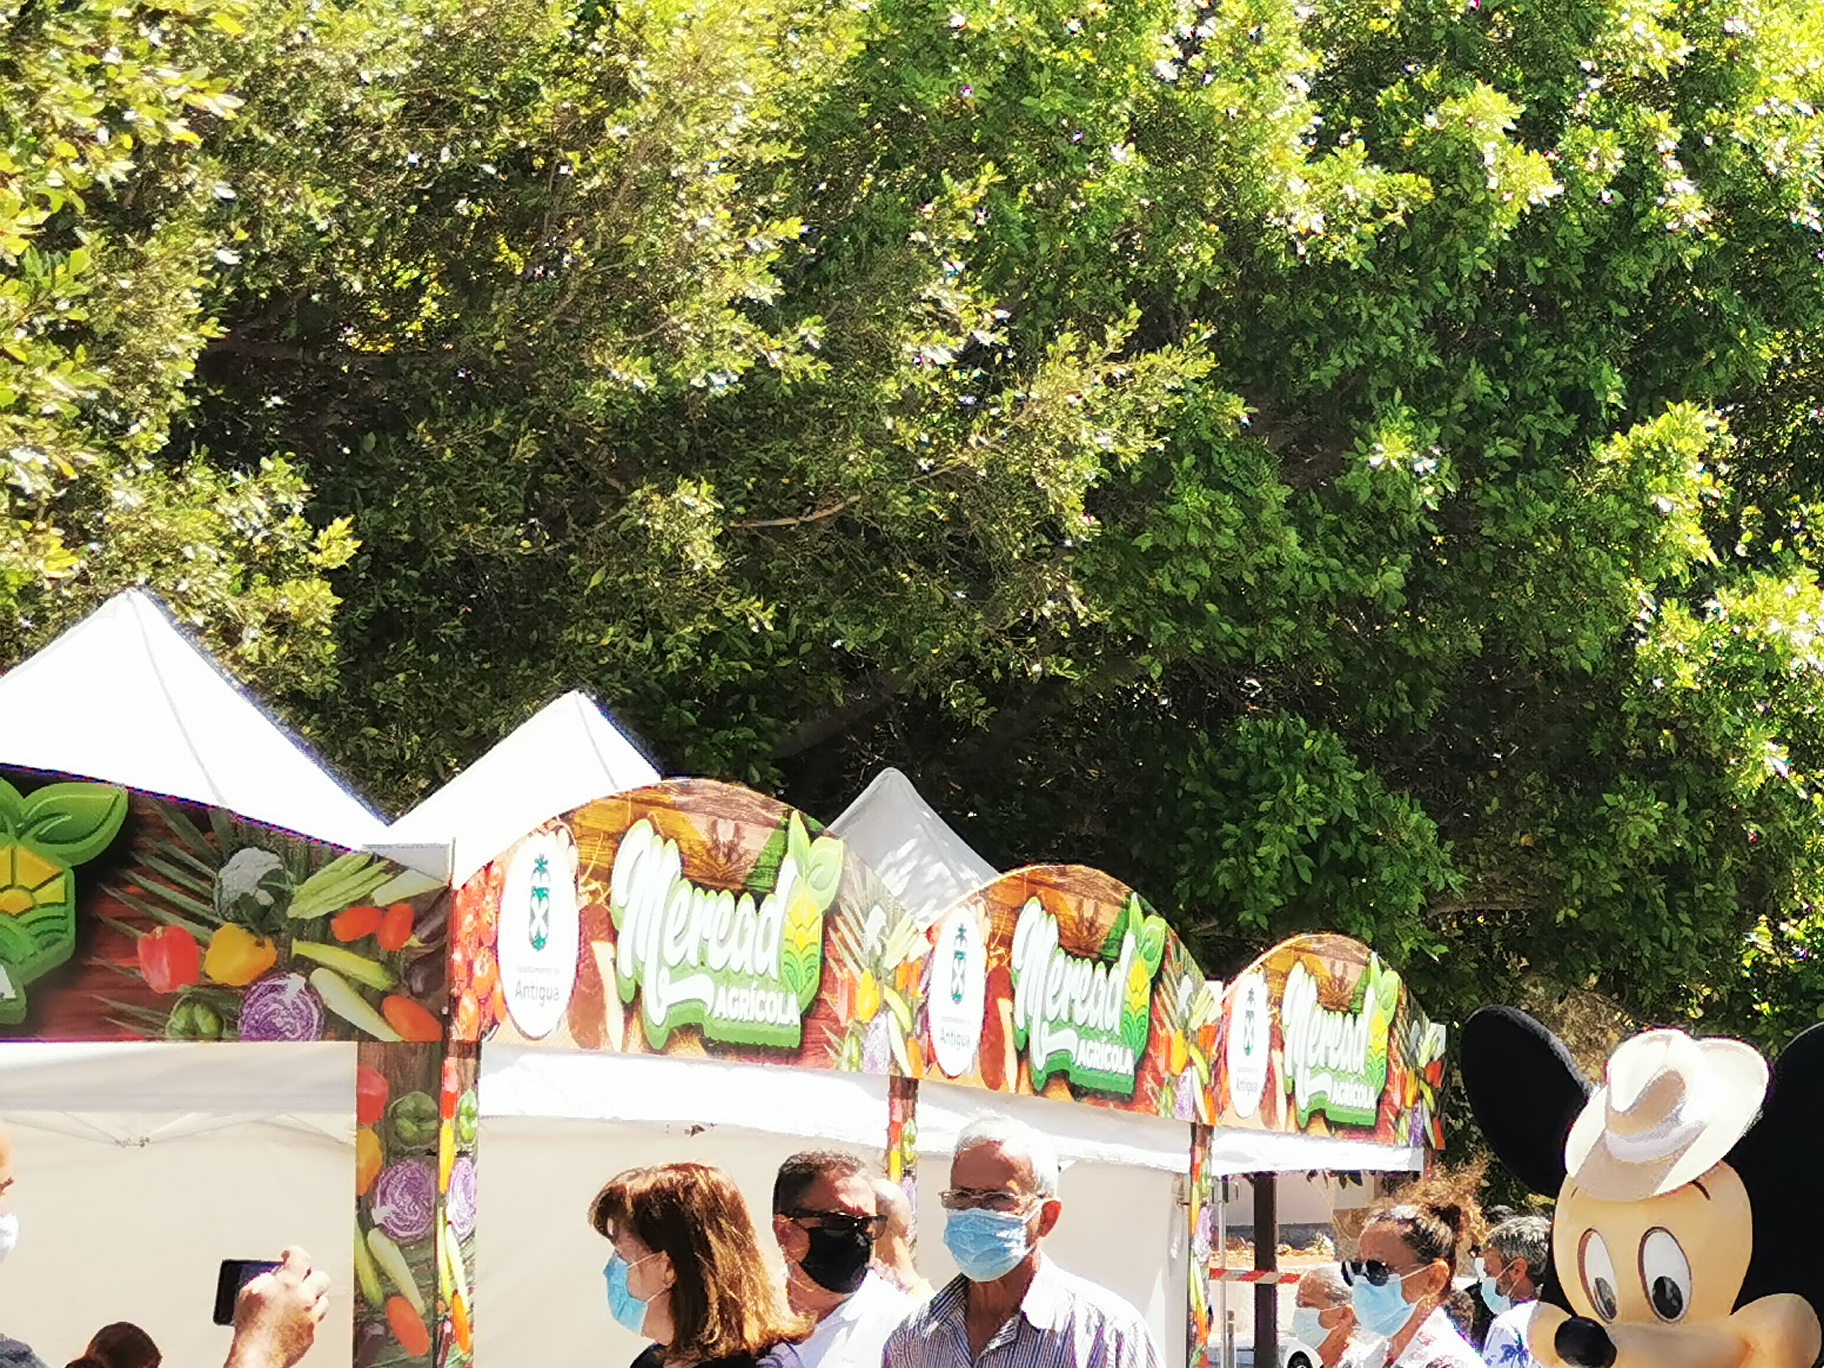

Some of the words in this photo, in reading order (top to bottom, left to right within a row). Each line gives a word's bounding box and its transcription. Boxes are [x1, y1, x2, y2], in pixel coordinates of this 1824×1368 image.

[514, 979, 560, 1007] Antigua
[714, 981, 800, 1025] AGRÍCOLA
[940, 1028, 971, 1051] Antigua
[1076, 1037, 1134, 1075] AGRÍCOLA
